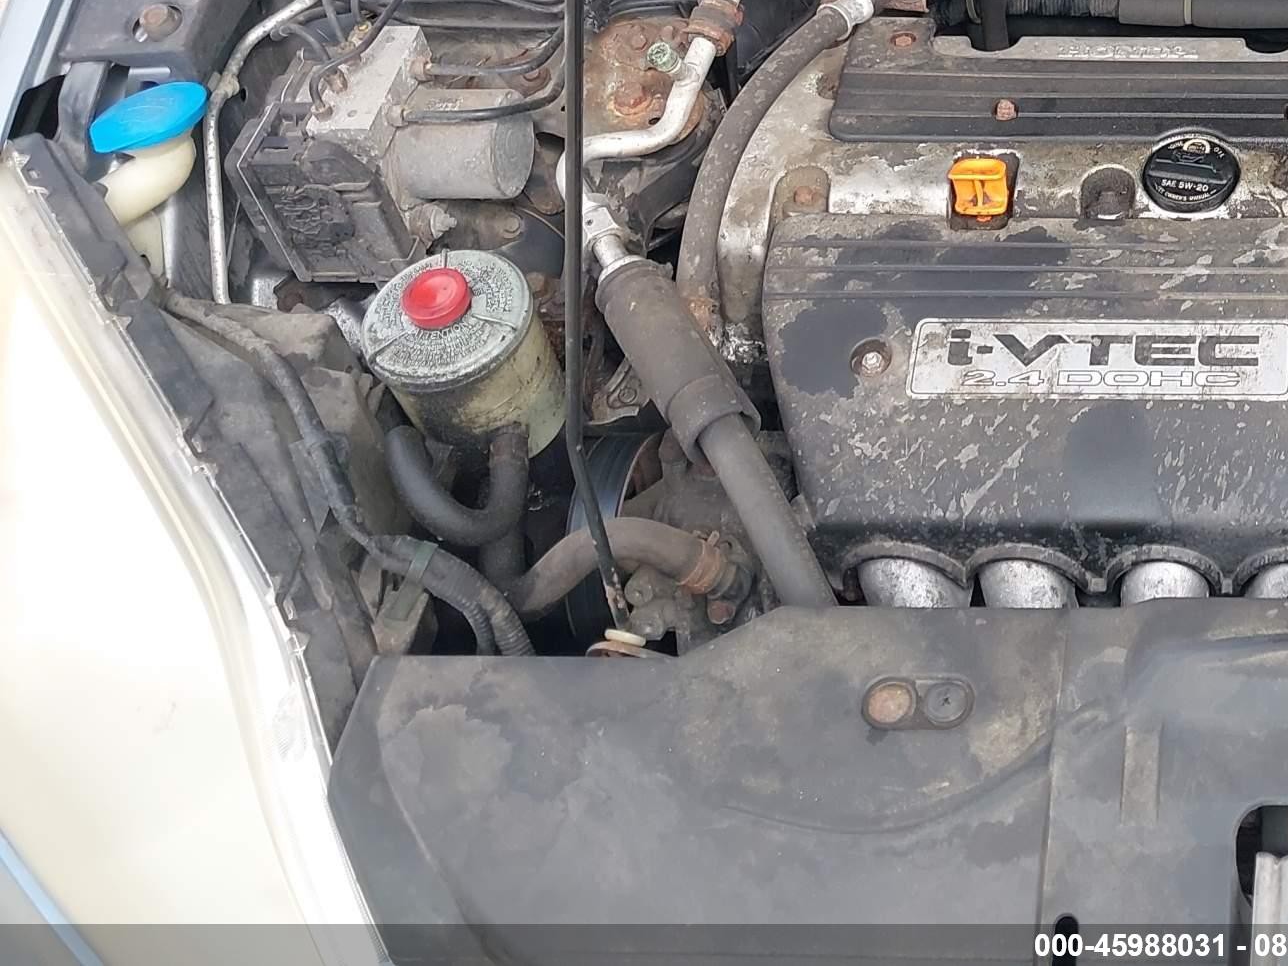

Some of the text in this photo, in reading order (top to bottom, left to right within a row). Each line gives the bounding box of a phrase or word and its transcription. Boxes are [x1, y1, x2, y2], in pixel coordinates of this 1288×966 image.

[1161, 179, 1209, 192] SAE 5W-20
[947, 329, 1260, 367] i-VTEC
[961, 369, 1241, 387] 2.4 DOHC
